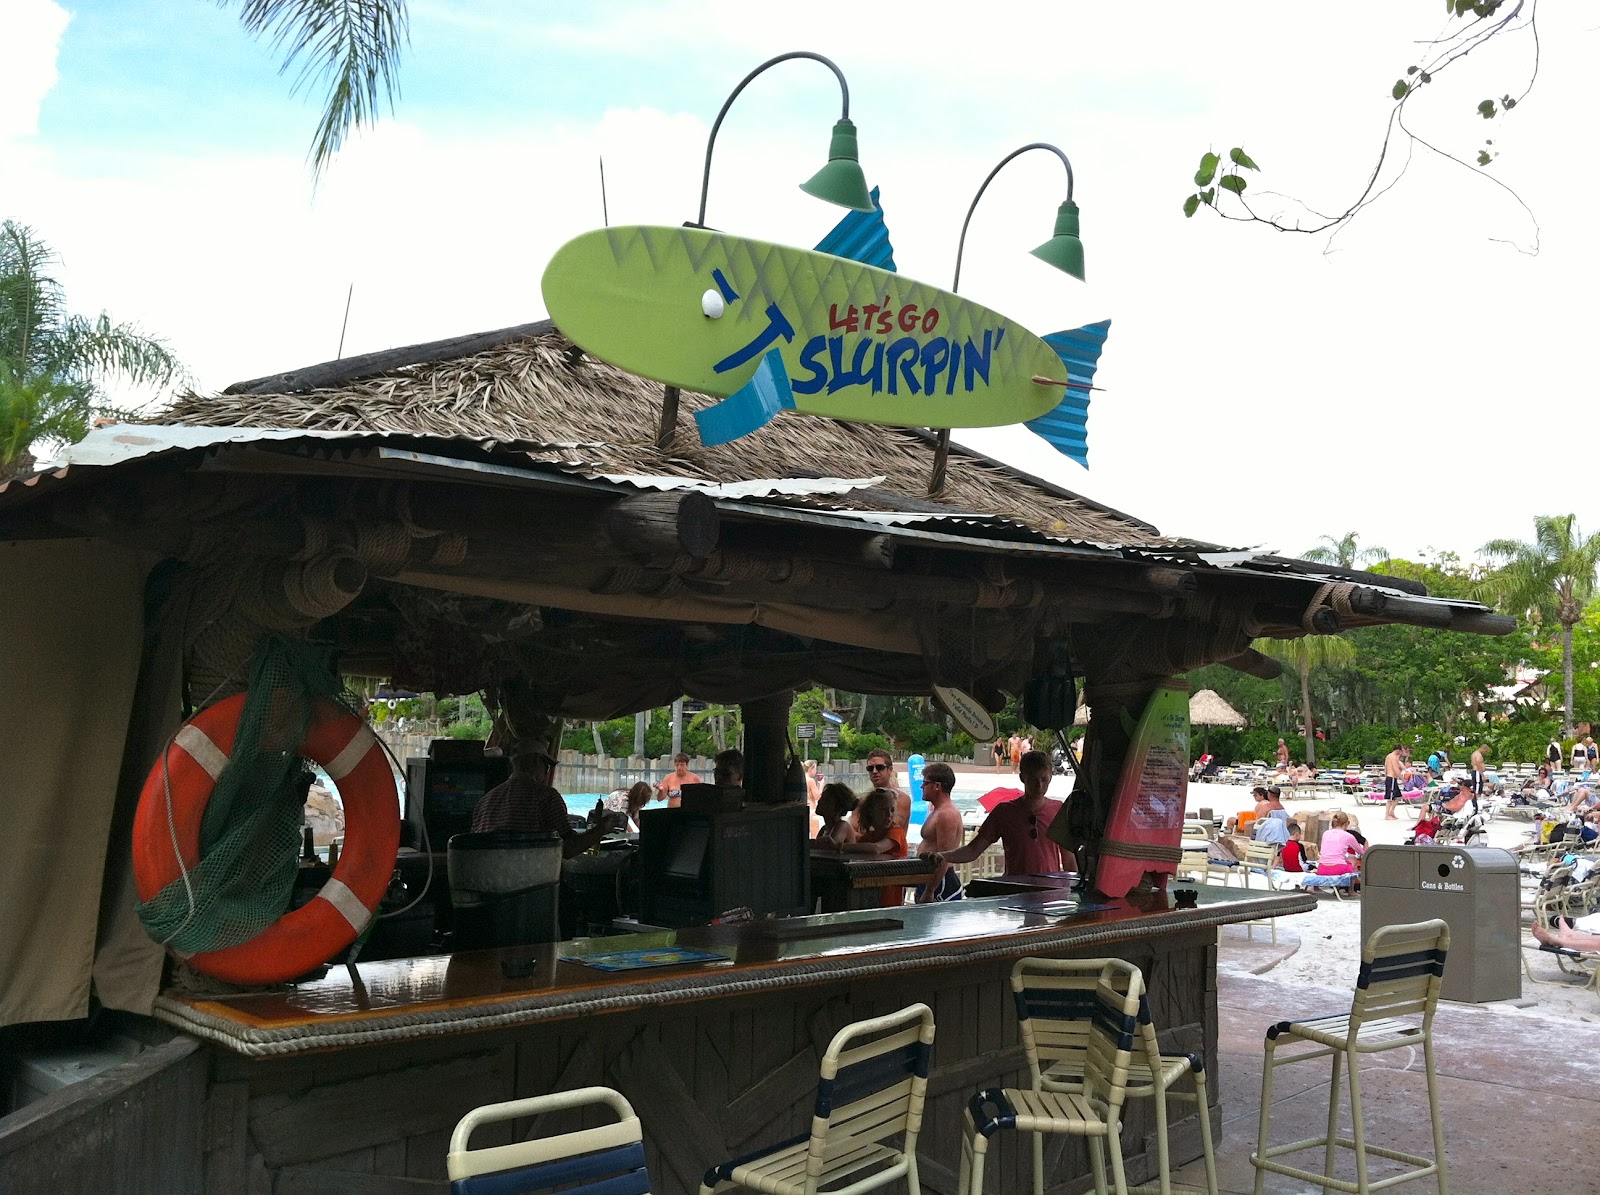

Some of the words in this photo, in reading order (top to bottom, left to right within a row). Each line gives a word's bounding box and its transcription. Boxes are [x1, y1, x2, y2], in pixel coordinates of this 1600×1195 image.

[829, 295, 893, 334] LET'S
[898, 304, 939, 333] GO
[791, 327, 1005, 396] SLURPIN'
[1421, 881, 1436, 889] Cans
[1444, 882, 1463, 890] Bottles
